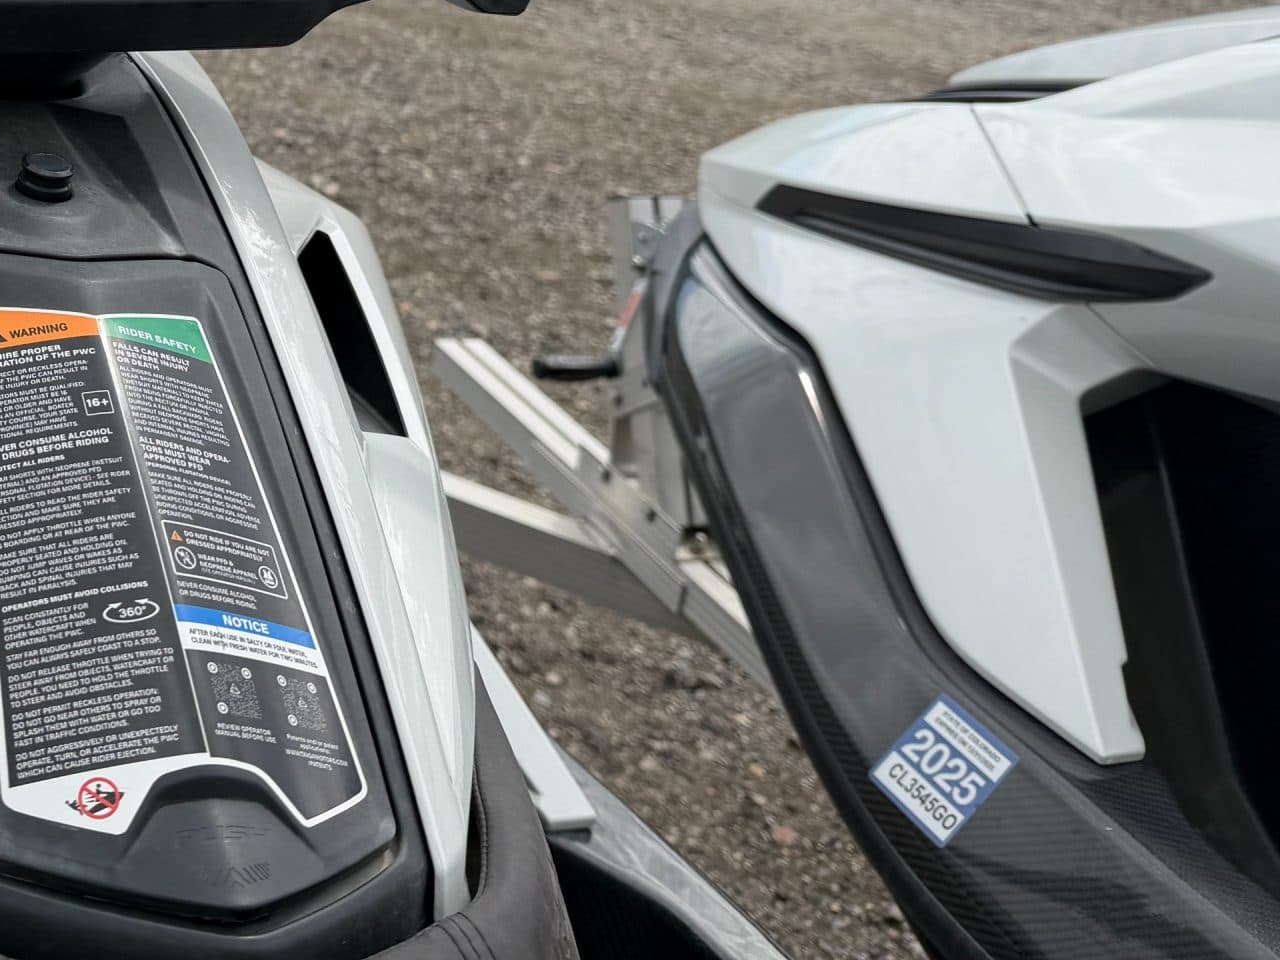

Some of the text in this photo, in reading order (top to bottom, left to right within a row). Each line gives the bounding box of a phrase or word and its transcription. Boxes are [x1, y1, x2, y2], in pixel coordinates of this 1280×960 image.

[9, 322, 68, 339] WARNING
[117, 325, 198, 354] RIDER SAFETY
[20, 344, 61, 356] PROPER
[35, 353, 48, 361] OF
[51, 350, 70, 358] THE
[72, 347, 96, 355] PWC
[112, 341, 191, 367] FALLS CAN RESULT
[125, 350, 160, 364] SEVERE
[159, 358, 189, 373] INJURY
[115, 355, 160, 371] OR DEATH
[86, 398, 109, 408] 16+
[1, 447, 34, 460] DRUGS
[36, 440, 73, 453] BEFORE
[75, 435, 109, 447] RIDING
[18, 433, 65, 448] CONSUME
[67, 427, 113, 439] ALCOHOL
[138, 435, 154, 444] ALL
[154, 438, 185, 452] RIDERS
[184, 445, 202, 456] AND
[22, 459, 35, 467] ALL
[37, 454, 65, 464] RIDERS
[140, 442, 211, 466] TORS MUST WEAR
[142, 451, 204, 472] APPROVED PFD
[3, 535, 41, 547] BOARDING
[64, 527, 83, 535] REAR
[6, 531, 21, 539] NOT
[23, 527, 44, 535] APPLY
[46, 520, 82, 531] THROTTLE
[83, 516, 105, 524] WHEN
[106, 512, 136, 520] ANYONE
[194, 532, 208, 540] NOT
[230, 540, 245, 549] YOU
[244, 544, 257, 553] ARE
[257, 548, 270, 556] NOT
[175, 579, 198, 590] NEVER
[188, 589, 211, 599] DRUGS
[1, 580, 148, 613] OPERATORS MUST AVOID COLLISIONS
[2, 602, 89, 625] SCAN CONSTANTLY FOR
[34, 614, 67, 627] OBJECTS
[68, 611, 85, 620] AND
[119, 606, 147, 619] 360°
[221, 614, 270, 634] NOTICE
[4, 617, 96, 641] OTHER WATERCRAFT WHEN
[4, 635, 47, 649] OPERATING
[48, 632, 63, 640] THE
[5, 652, 22, 661] STAY
[23, 649, 38, 658] FAR
[39, 643, 71, 654] ENOUGH
[72, 638, 92, 648] AWAY
[92, 634, 115, 644] FROM
[115, 630, 145, 640] OTHERS
[6, 661, 22, 670] YOU
[23, 657, 39, 667] CAN
[40, 651, 69, 663] ALWAYS
[69, 646, 96, 657] SAFELY
[96, 642, 121, 652] COAST
[7, 646, 174, 682] DO NOT RELEASE THROTTLE WHEN TRYING TO
[8, 680, 32, 691] STEER
[33, 676, 53, 686] AWAY
[54, 671, 77, 681] FROM
[112, 657, 161, 670] WATERCRAFT
[41, 684, 57, 693] YOU
[58, 679, 79, 689] NEED
[79, 677, 90, 685] TO
[91, 673, 113, 683] HOLD
[114, 670, 129, 678] THE
[130, 664, 168, 676] THROTTLE
[10, 700, 21, 708] TO
[21, 695, 45, 706] STEER
[46, 691, 63, 700] AND
[64, 686, 88, 697] AVOID
[15, 724, 178, 761] DO NOT AGGRESSIVELY OR UNEXPECTEDLY
[79, 748, 91, 756] OR
[92, 739, 142, 754] ACCELERATE
[143, 736, 159, 744] THE
[160, 733, 179, 742] PWC
[16, 767, 44, 779] WHICH
[45, 763, 63, 773] CAN
[63, 757, 90, 769] CAUSE
[91, 752, 116, 763] RIDER
[900, 728, 986, 805] 2025
[889, 763, 958, 830] CL3545GO
